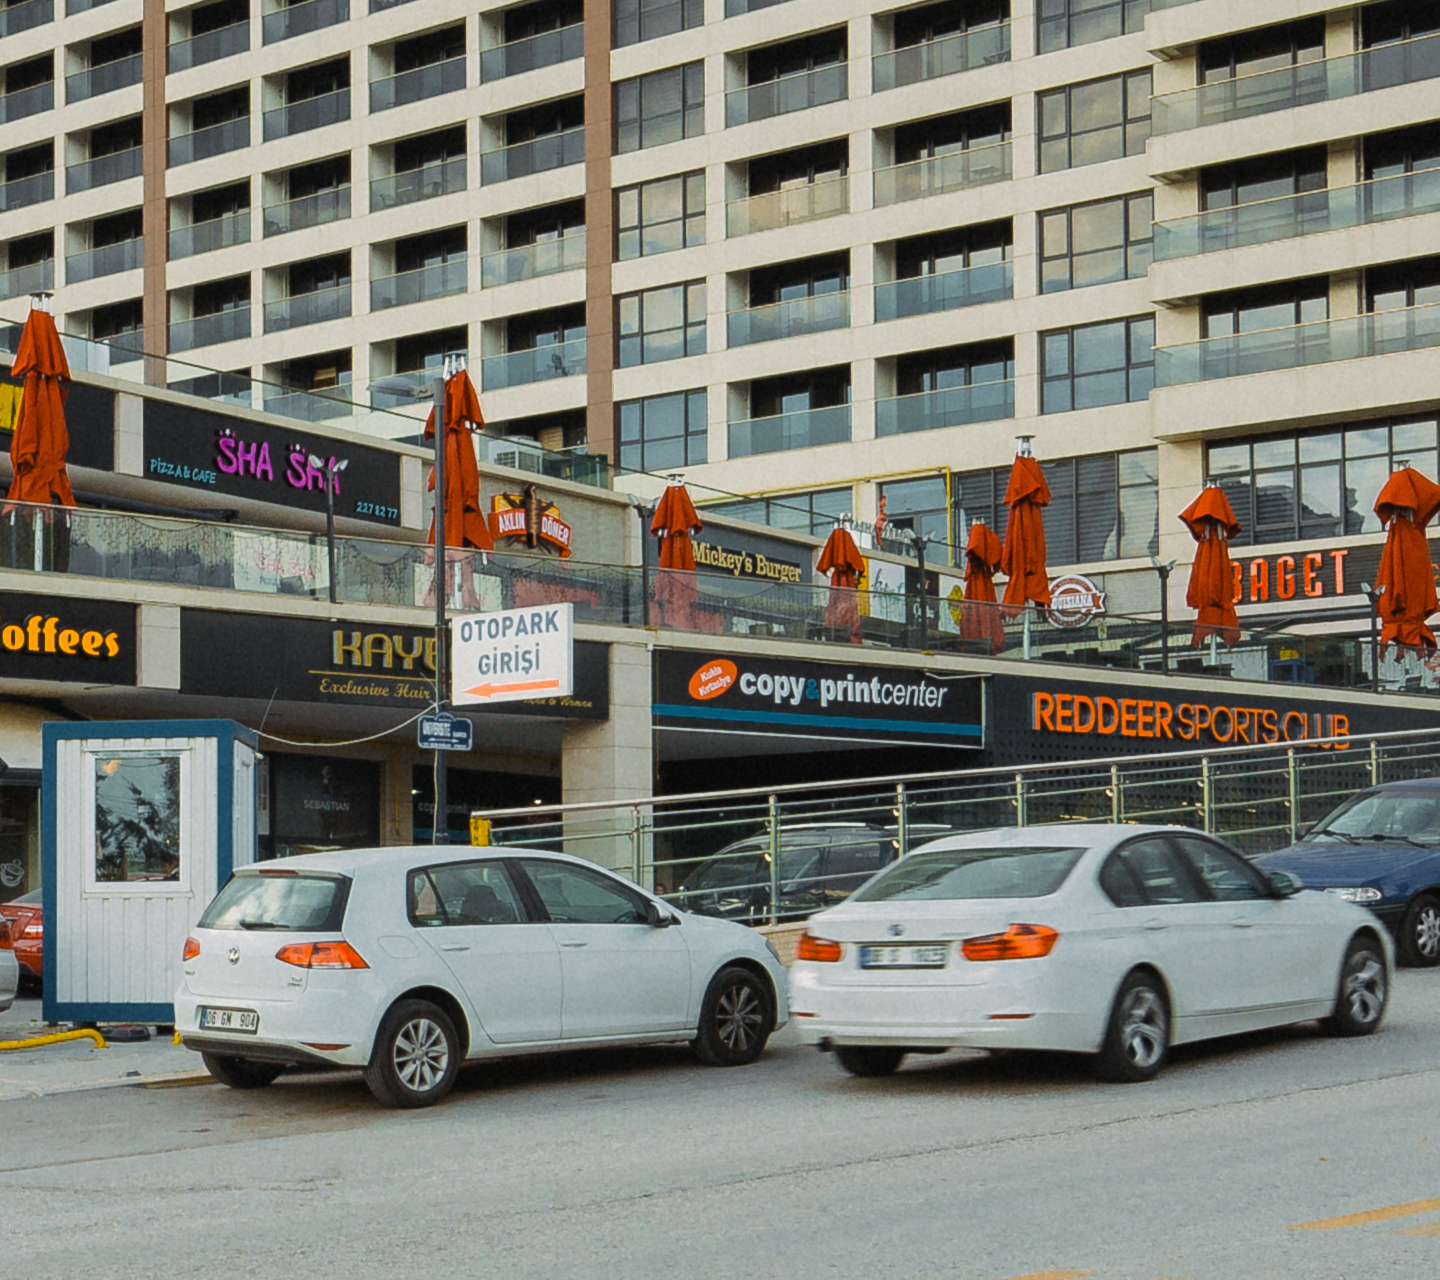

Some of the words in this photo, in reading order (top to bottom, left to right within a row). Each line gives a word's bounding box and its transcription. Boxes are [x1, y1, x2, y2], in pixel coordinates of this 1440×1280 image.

[217, 437, 274, 482] SHA
[192, 467, 217, 485] CAFE
[356, 501, 373, 514] 227
[541, 515, 570, 546] DÖNER
[691, 540, 753, 577] Mickey's
[755, 553, 803, 583] Burger
[460, 609, 560, 643] OTOPARK
[478, 642, 541, 676] GİRİŞİ
[319, 677, 390, 697] Exclusive
[393, 682, 432, 700] Hair
[1176, 703, 1279, 744] SPORTS
[1282, 711, 1351, 751] CLUB
[303, 798, 350, 812] SEBASTIAN
[239, 1013, 257, 1029] 904
